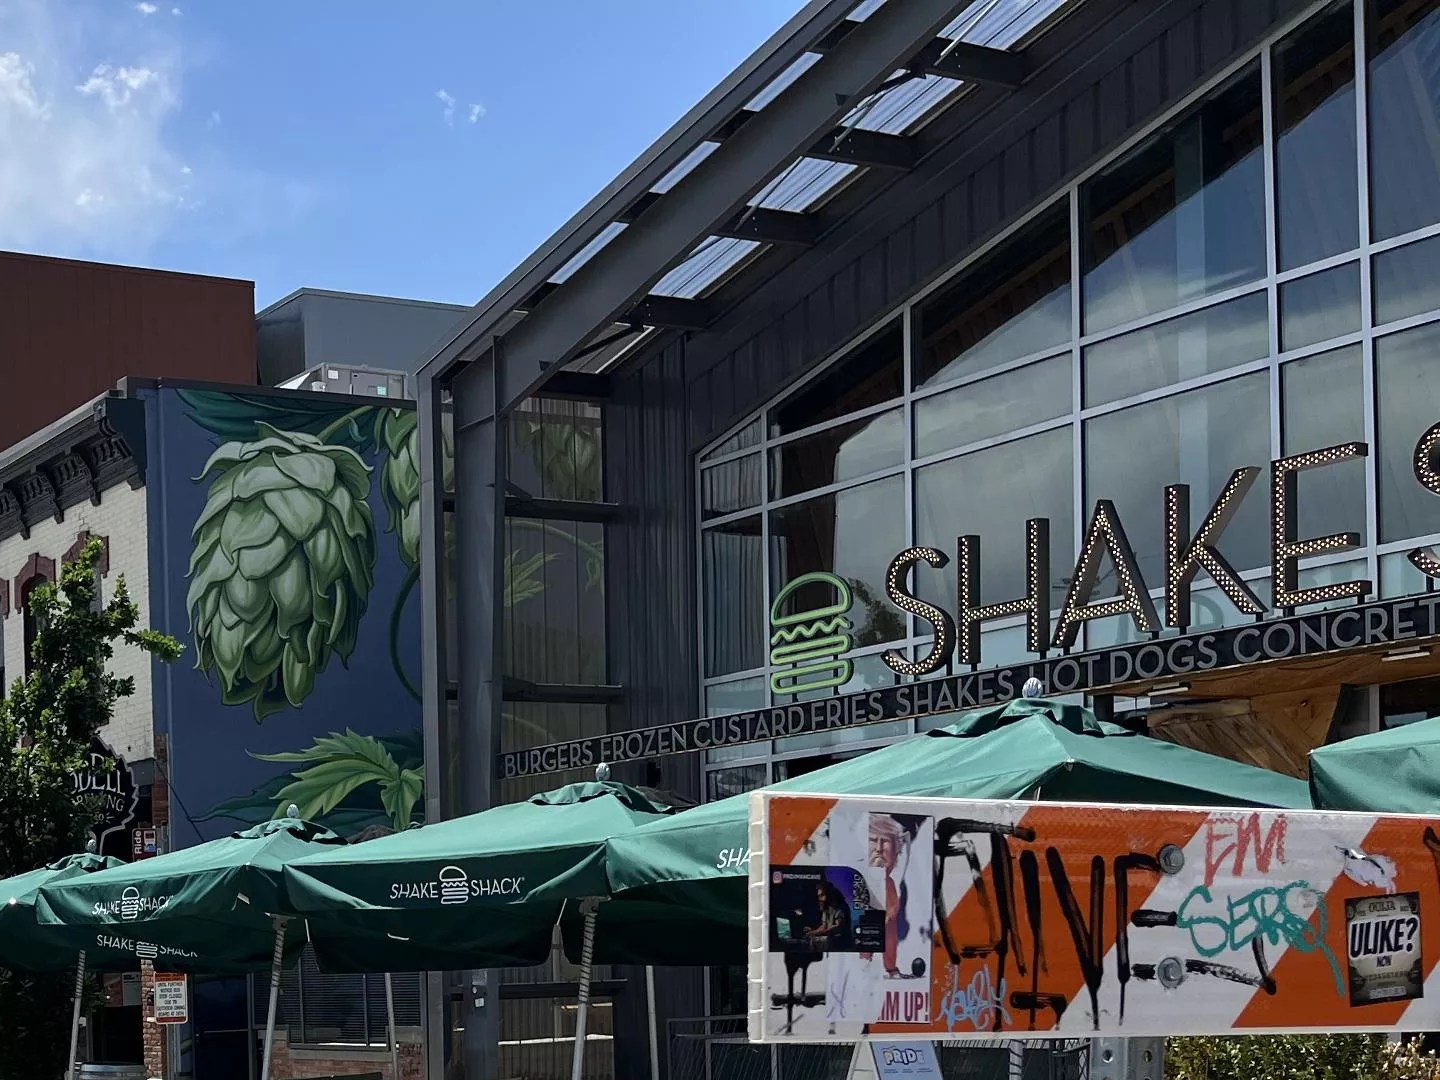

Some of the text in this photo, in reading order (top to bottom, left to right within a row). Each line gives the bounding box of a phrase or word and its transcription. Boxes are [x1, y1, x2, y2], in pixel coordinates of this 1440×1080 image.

[880, 440, 1373, 677] SHAKE
[504, 740, 594, 779] BURGERS
[600, 724, 687, 762] FROZEN
[693, 704, 805, 748] CUSTARD
[812, 691, 884, 731] FRIES
[896, 670, 1015, 717] SHAKES
[1028, 654, 1104, 694] HOT
[1109, 635, 1218, 684] DOGS
[134, 830, 143, 854] Ride
[389, 877, 521, 900] SHAKE SHACK
[91, 900, 121, 915] SHAKE
[97, 934, 135, 951] SHAKE
[1350, 917, 1419, 958] ULIKE?
[905, 991, 929, 1022] UP!
[882, 1046, 924, 1066] PRIDE
